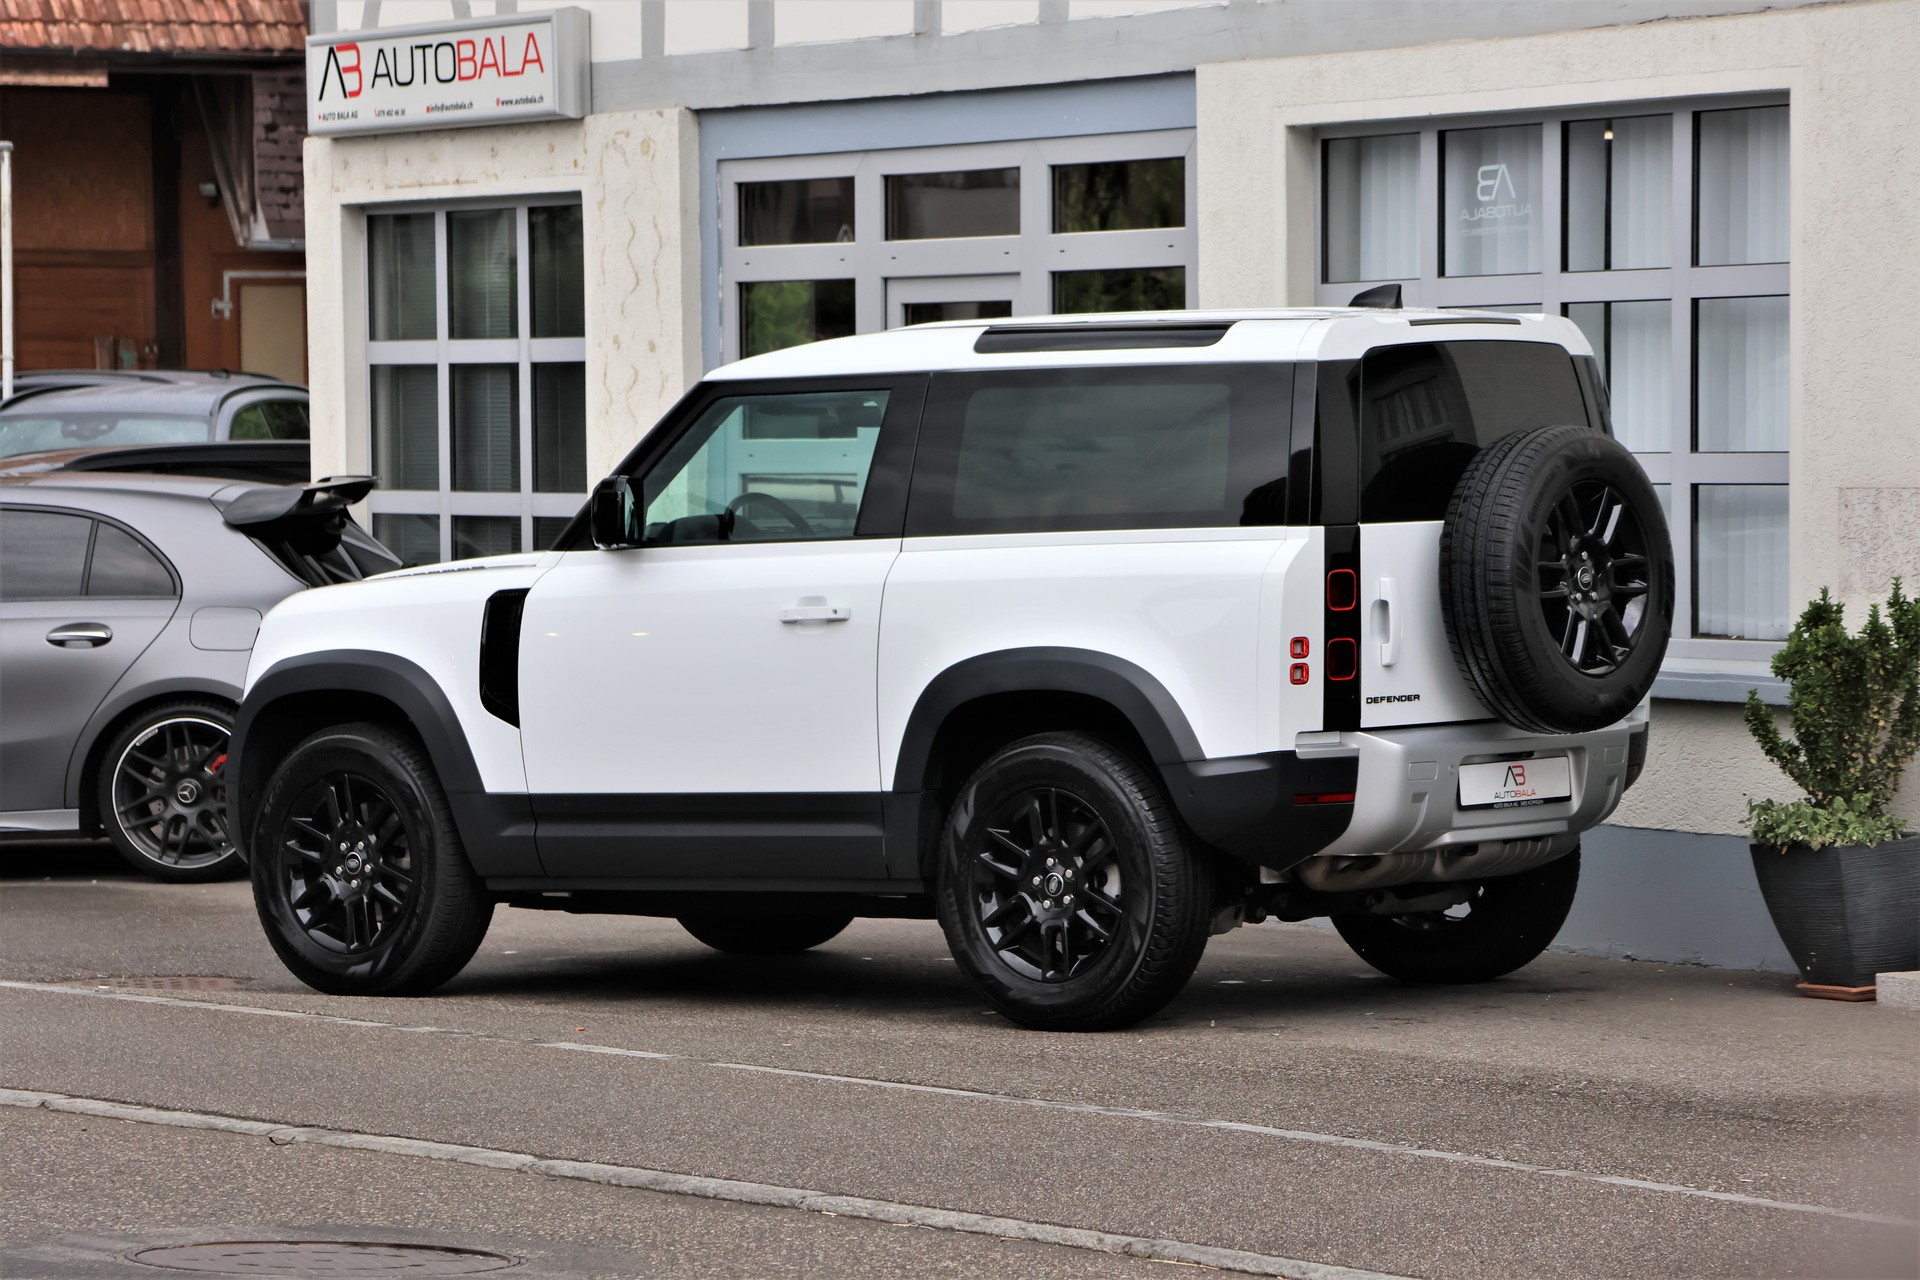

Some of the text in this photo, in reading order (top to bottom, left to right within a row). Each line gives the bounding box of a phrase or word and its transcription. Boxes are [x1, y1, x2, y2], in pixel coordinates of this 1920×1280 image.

[371, 32, 544, 89] AUTOBALA
[501, 94, 544, 106] www.autobala.ch
[430, 100, 473, 112] info@autobala.ch
[322, 110, 358, 121] AUTO BALA AG
[1366, 694, 1421, 704] DEFENDER
[1494, 789, 1537, 800] AUTOBALA
